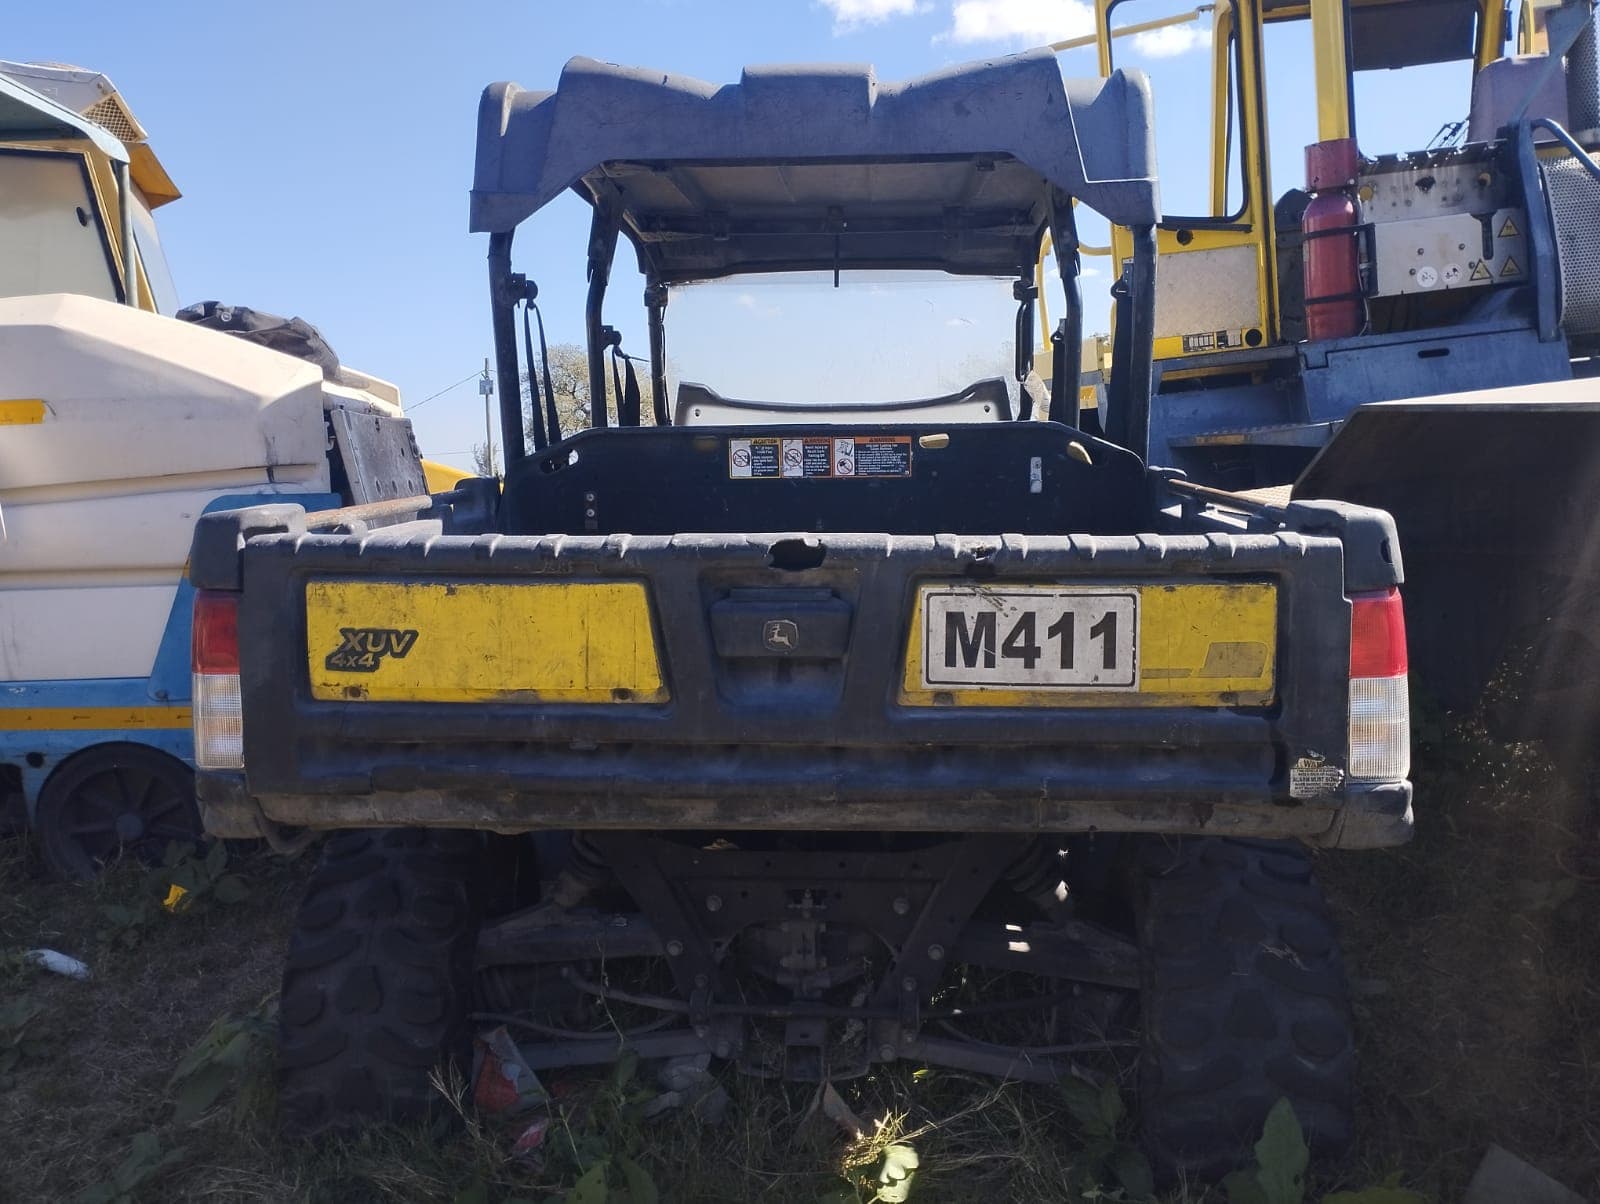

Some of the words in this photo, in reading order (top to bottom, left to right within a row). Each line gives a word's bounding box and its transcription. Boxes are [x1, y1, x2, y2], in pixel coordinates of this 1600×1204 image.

[341, 632, 412, 654] XUV
[945, 611, 1117, 669] M411
[330, 652, 375, 668] 4x4
